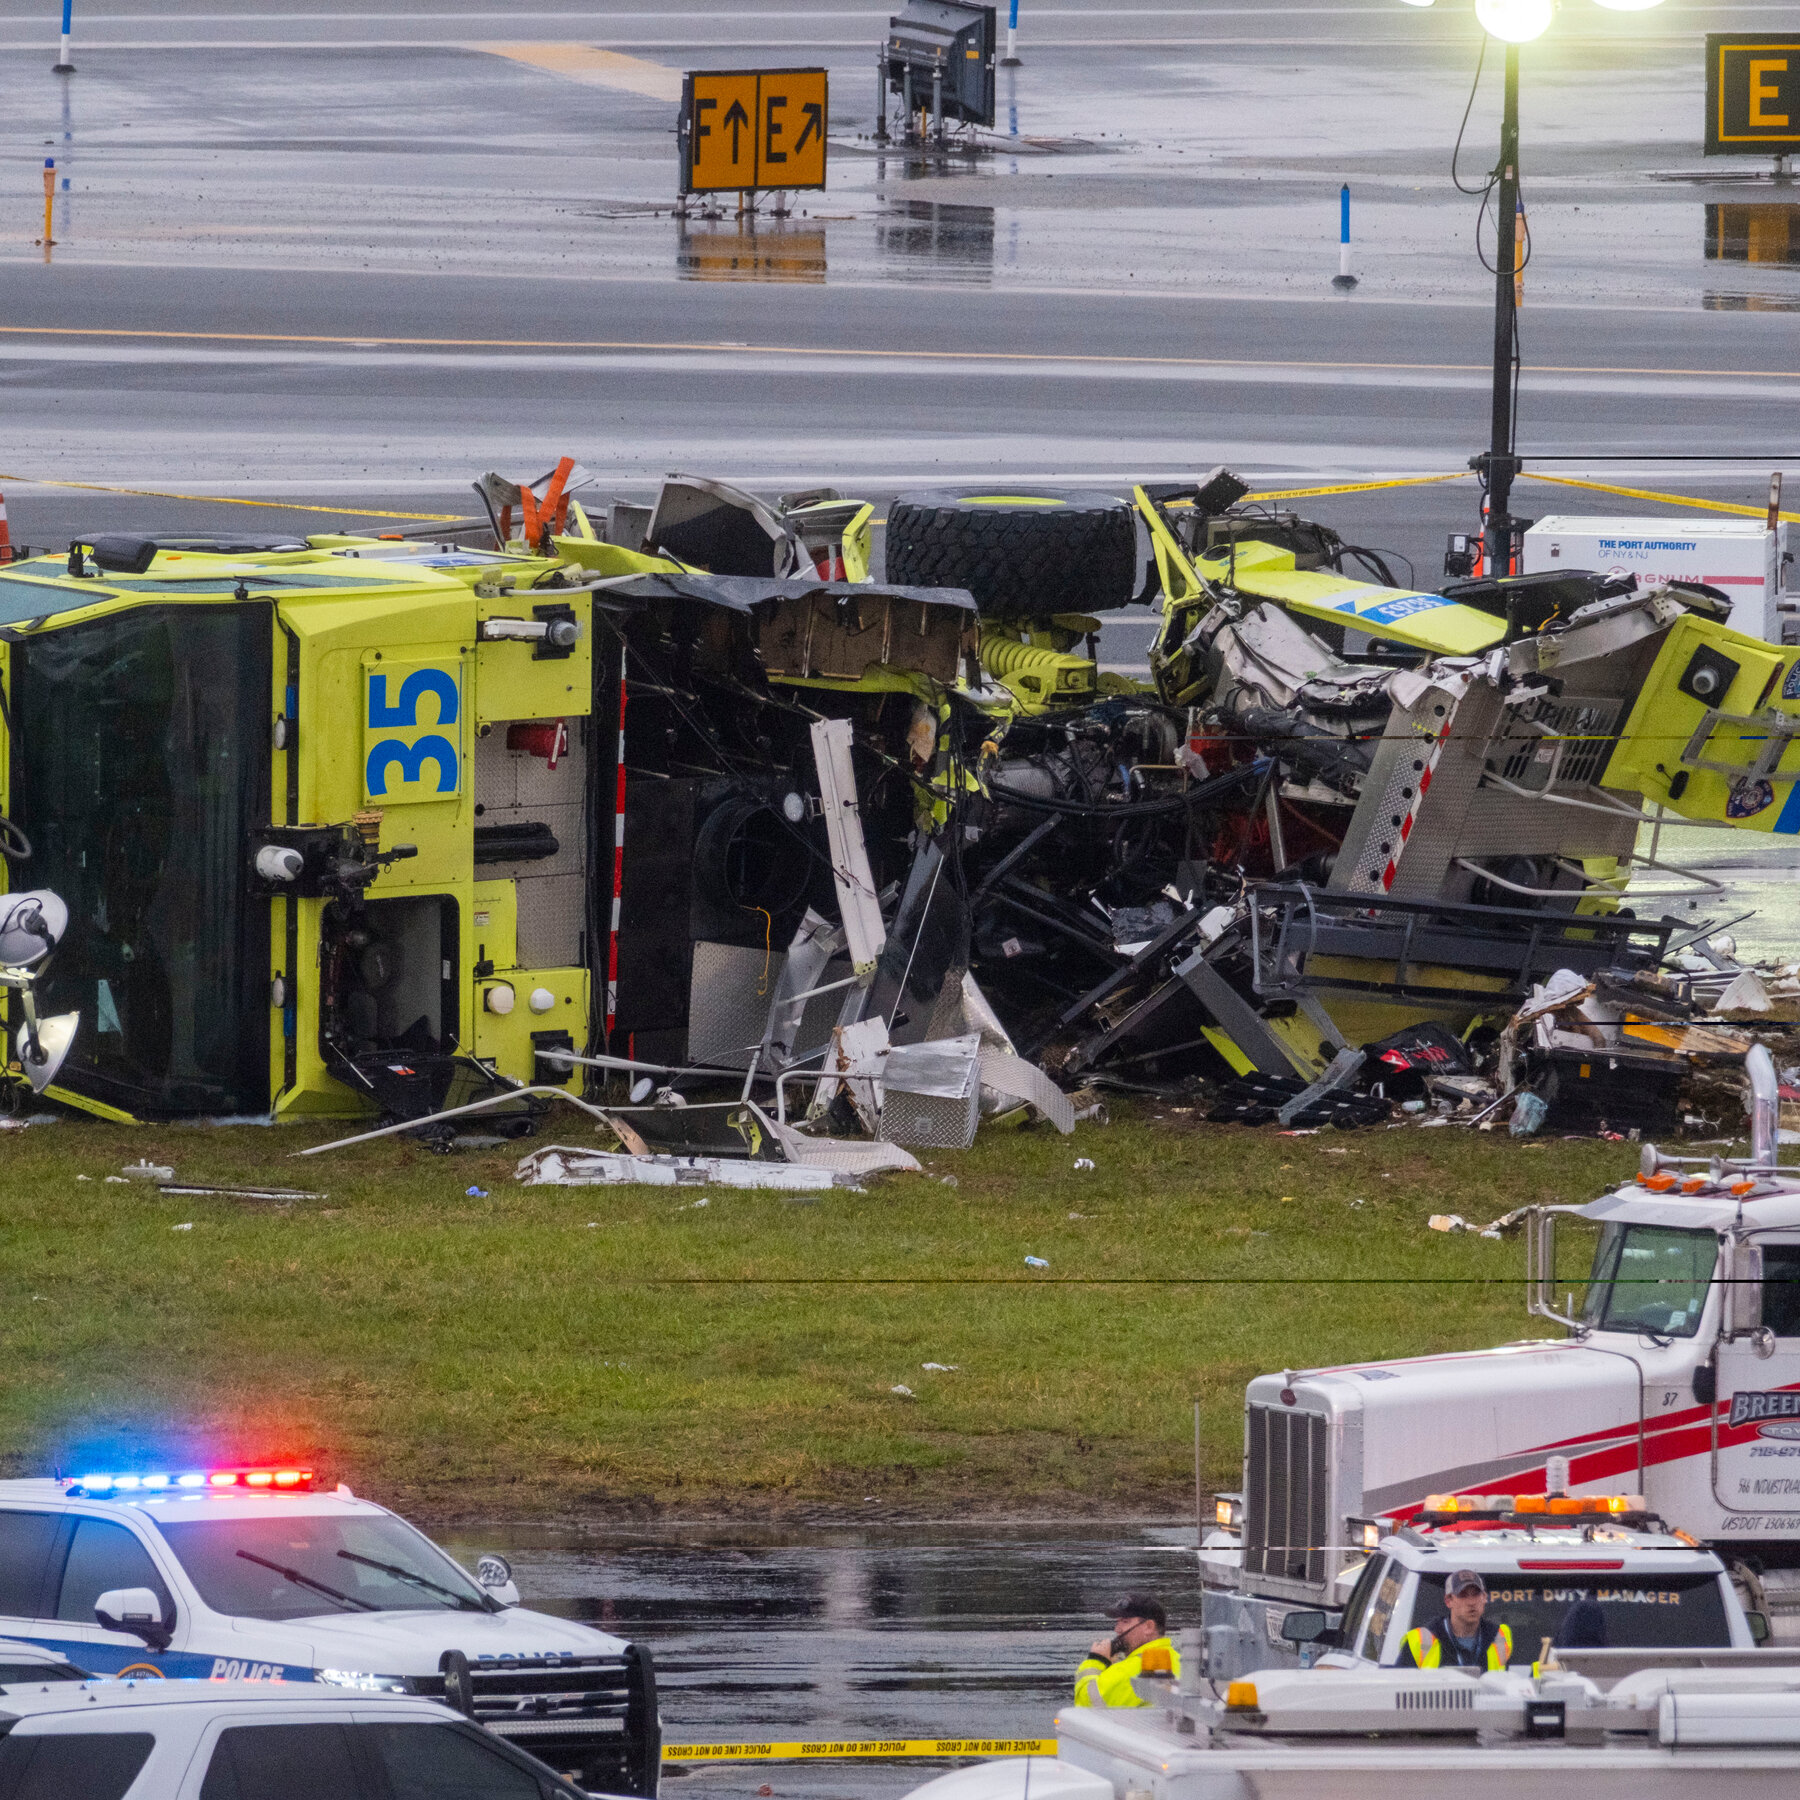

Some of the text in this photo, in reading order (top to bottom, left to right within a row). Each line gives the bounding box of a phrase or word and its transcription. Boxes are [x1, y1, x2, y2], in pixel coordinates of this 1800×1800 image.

[1749, 59, 1788, 127] E
[694, 96, 787, 166] F E
[1599, 540, 1696, 551] THE PORT AUTHORITY
[1598, 549, 1611, 559] OF
[1613, 550, 1626, 559] NY
[1635, 550, 1648, 560] NJ
[1634, 574, 1698, 584] AGNUM
[366, 668, 458, 796] 35
[1662, 1391, 1678, 1406] 87
[1721, 1516, 1763, 1530] USDOT
[1490, 1589, 1681, 1605] PORT DUTY MANAGER
[209, 1658, 284, 1681] POLICE
[667, 1744, 772, 1757] POLICE LINE DO NOT CROSS
[801, 1742, 906, 1754] POLICE LINE DO NOT CROSS
[936, 1740, 1041, 1752] POLICE LINE DO NOT CROSS
